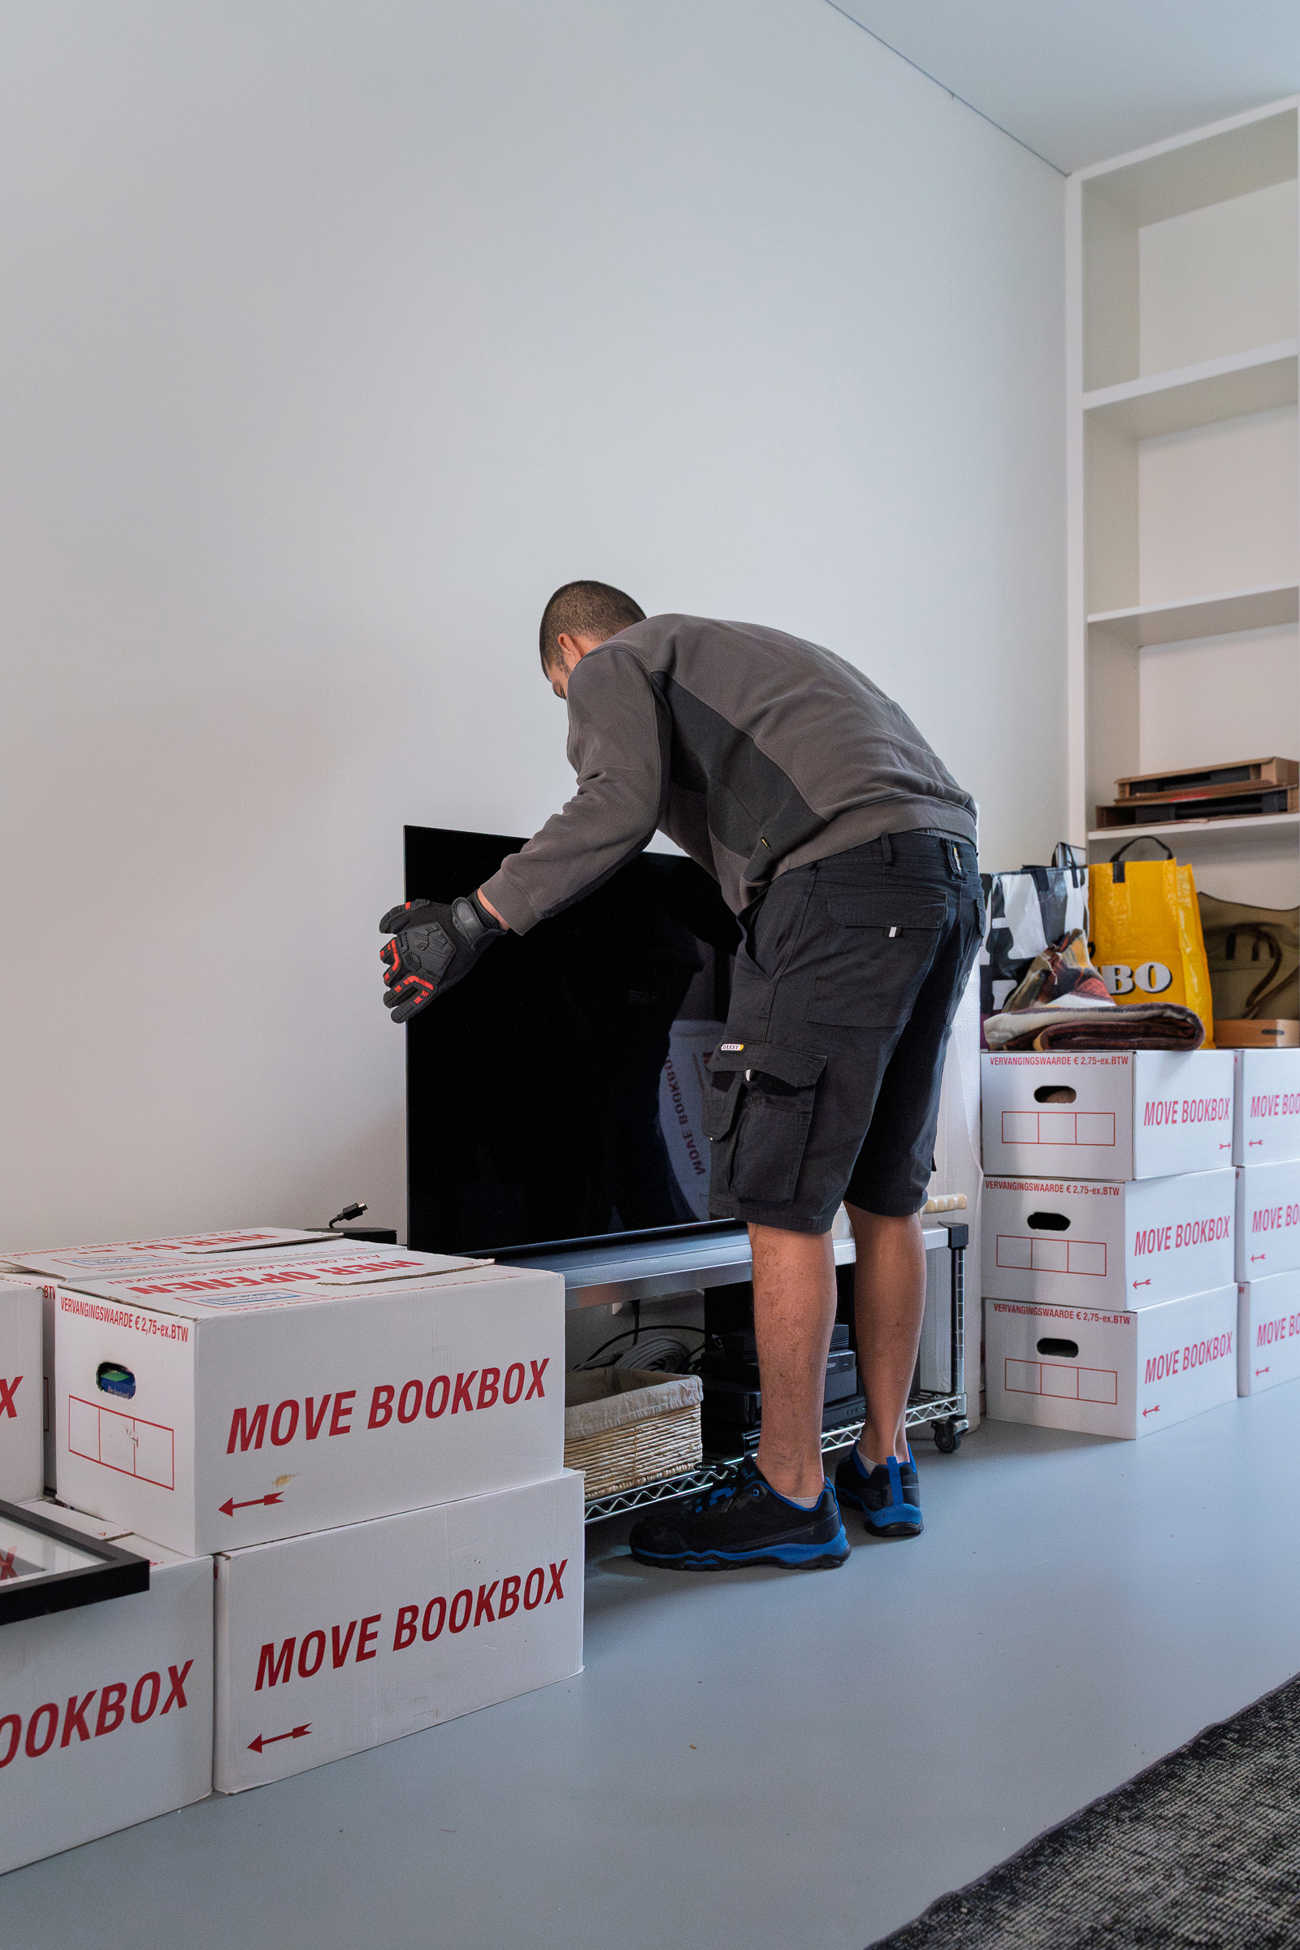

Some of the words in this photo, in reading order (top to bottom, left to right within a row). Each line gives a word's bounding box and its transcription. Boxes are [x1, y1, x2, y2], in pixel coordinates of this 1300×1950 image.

[1102, 962, 1173, 996] BO
[990, 1056, 1071, 1065] VERVANGINGSWAARDE
[1074, 1056, 1079, 1065] €
[1144, 1099, 1180, 1127] MOVE
[1181, 1097, 1231, 1124] BOOKBOX
[1251, 1095, 1280, 1118] MOVE
[985, 1181, 1063, 1193] VERVANGINGSWAARDE
[1066, 1184, 1071, 1194] €
[1253, 1207, 1283, 1233] MOVE
[1134, 1226, 1173, 1256] MOVE
[1176, 1216, 1231, 1248] BOOKBOX
[315, 1259, 425, 1276] HIER
[127, 1271, 321, 1295] OPENEN
[61, 1296, 132, 1328] VERVANGINGSWAARDE
[135, 1316, 141, 1330] €
[993, 1303, 1074, 1319] VERVANGINGSWAARDE
[1076, 1311, 1081, 1320] €
[1257, 1317, 1286, 1346] MOVE
[1145, 1349, 1180, 1384] MOVE
[1182, 1331, 1232, 1370] BOOKBOX
[226, 1390, 356, 1454] MOVE
[368, 1358, 550, 1430] BOOKBOX
[255, 1613, 382, 1691] MOVE
[393, 1559, 568, 1651] BOOKBOX
[0, 1660, 194, 1769] OOKBOX
